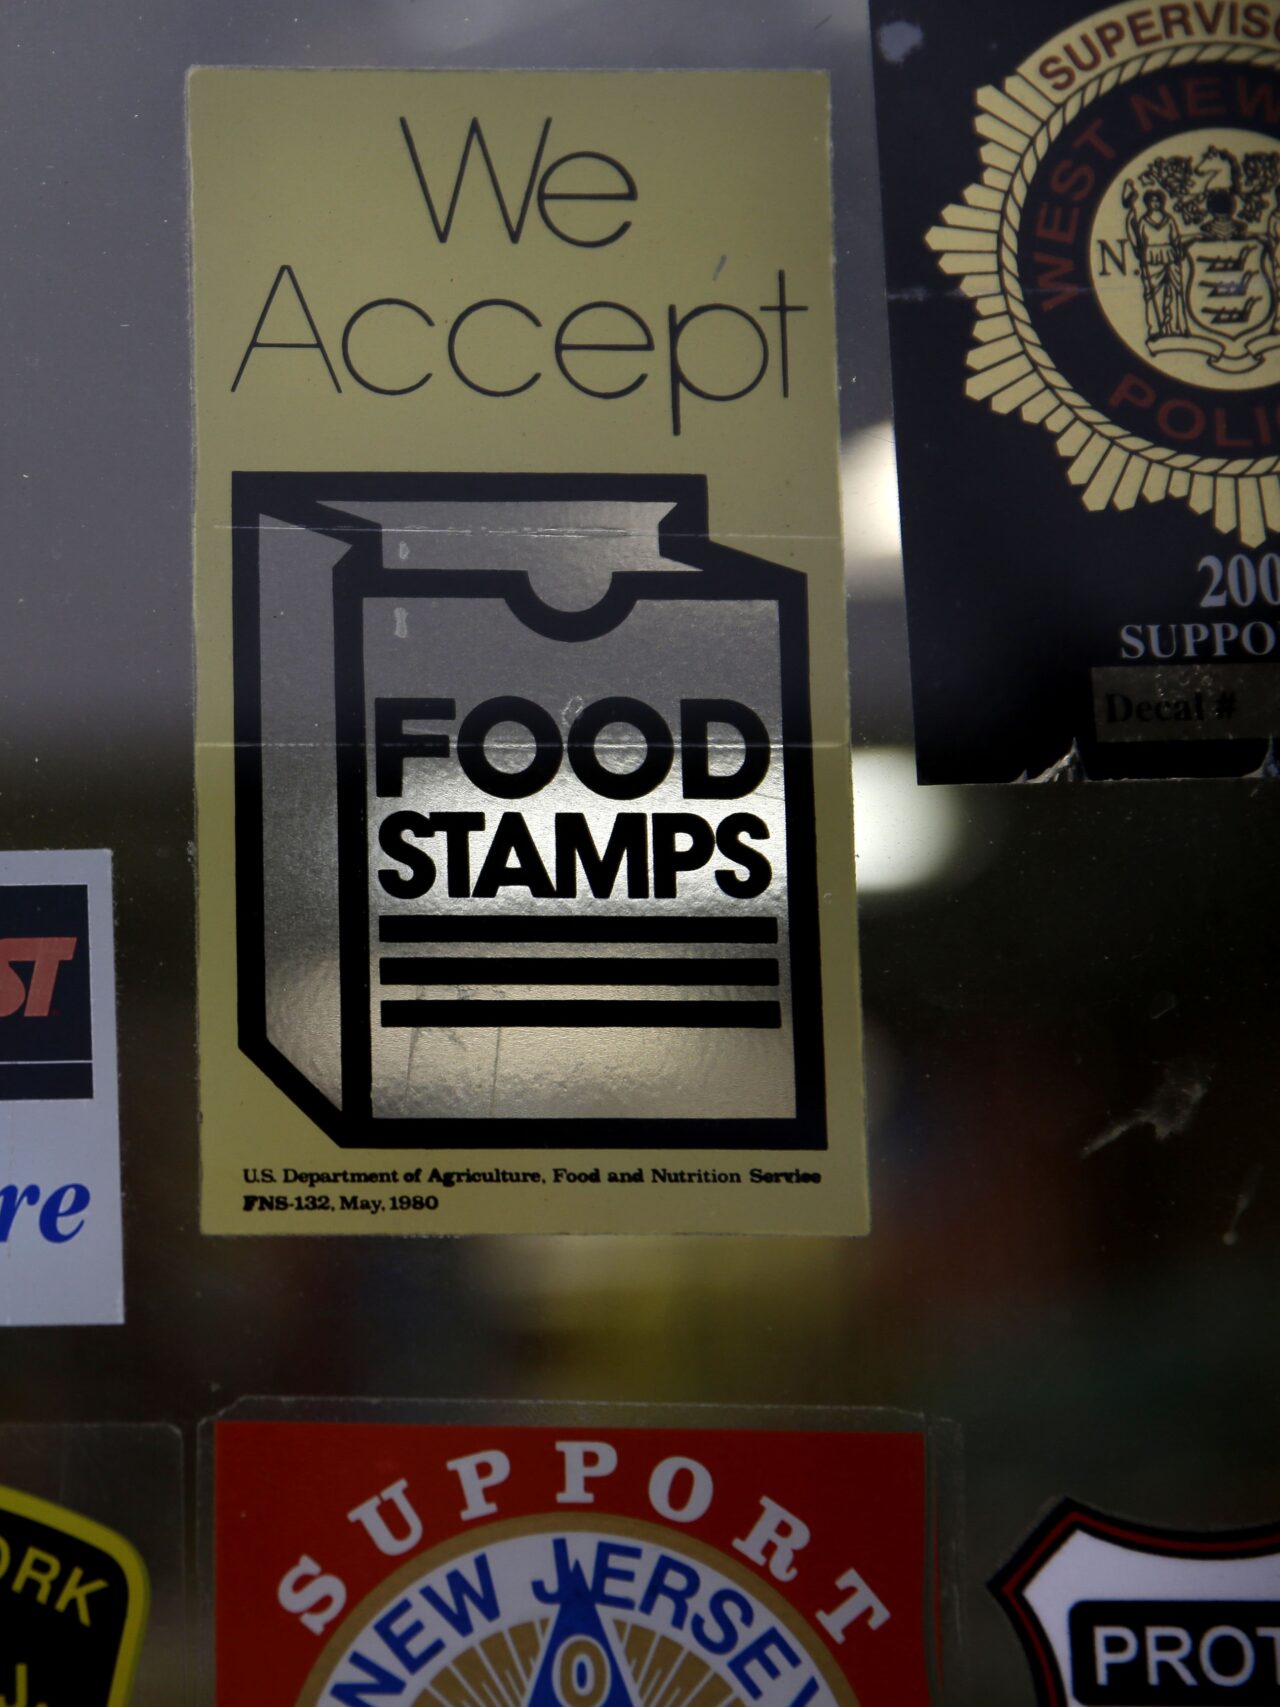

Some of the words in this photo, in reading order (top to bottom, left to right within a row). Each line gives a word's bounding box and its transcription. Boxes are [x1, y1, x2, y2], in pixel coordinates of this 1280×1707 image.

[1038, 0, 1280, 91] SUPERVIS
[399, 115, 638, 248] We
[1032, 118, 1118, 313] WEST
[1128, 75, 1280, 133] NEW
[1097, 239, 1141, 277] N.
[230, 264, 809, 437] Accept
[1109, 373, 1280, 449] POLI
[1121, 620, 1280, 659] SUPPO
[375, 695, 772, 800] FOOD
[1106, 691, 1205, 723] Decal
[378, 810, 773, 899] STAMPS
[243, 1168, 277, 1183] U.S.
[283, 1168, 399, 1187] Department
[403, 1168, 423, 1183] of
[426, 1168, 546, 1187] Agriculture,
[552, 1168, 601, 1183] Food
[607, 1168, 645, 1183] and
[651, 1168, 742, 1183] Nutrition
[339, 1195, 386, 1214] May,
[389, 1195, 440, 1211] 1980
[277, 1440, 892, 1645] SUPPORT
[330, 1553, 503, 1707] NEW
